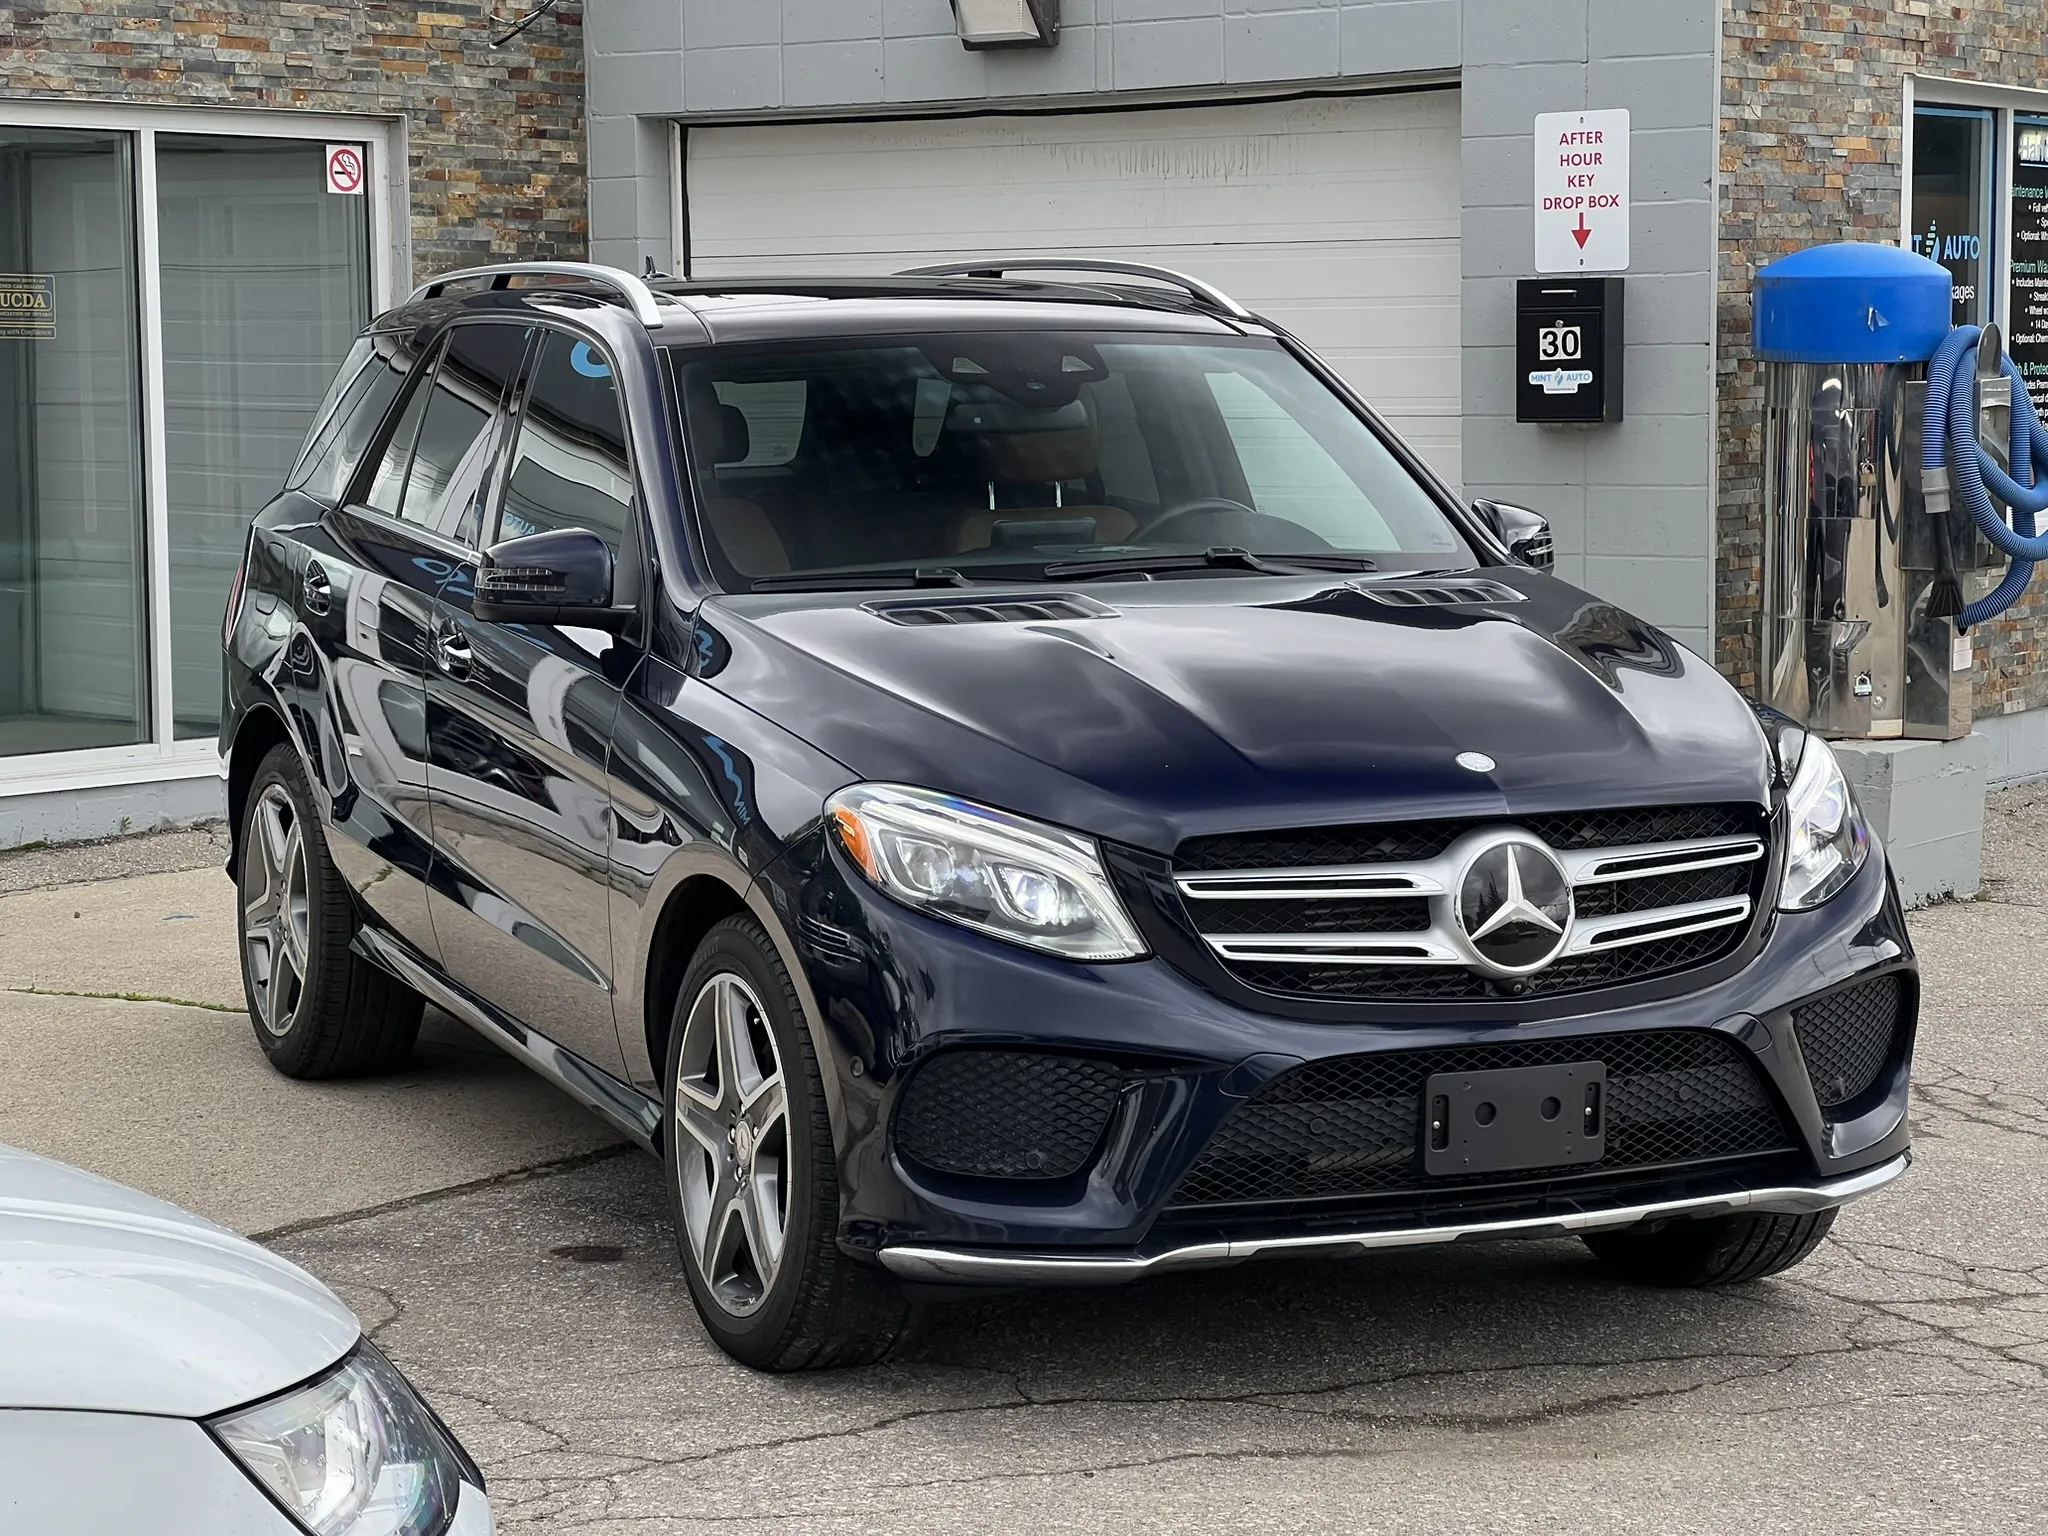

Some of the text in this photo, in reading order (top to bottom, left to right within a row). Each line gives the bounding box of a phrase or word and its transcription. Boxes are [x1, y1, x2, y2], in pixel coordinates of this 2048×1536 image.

[1558, 130, 1604, 146] AFTER
[1559, 152, 1603, 167] HOUR
[1567, 173, 1595, 188] KEY
[1542, 193, 1620, 211] DROP BOX
[1943, 235, 1980, 260] AUTO
[2010, 259, 2036, 273] Premium
[0, 293, 46, 308] UCDA
[1541, 329, 1580, 359] 30
[1531, 373, 1590, 382] MINT AUTO
